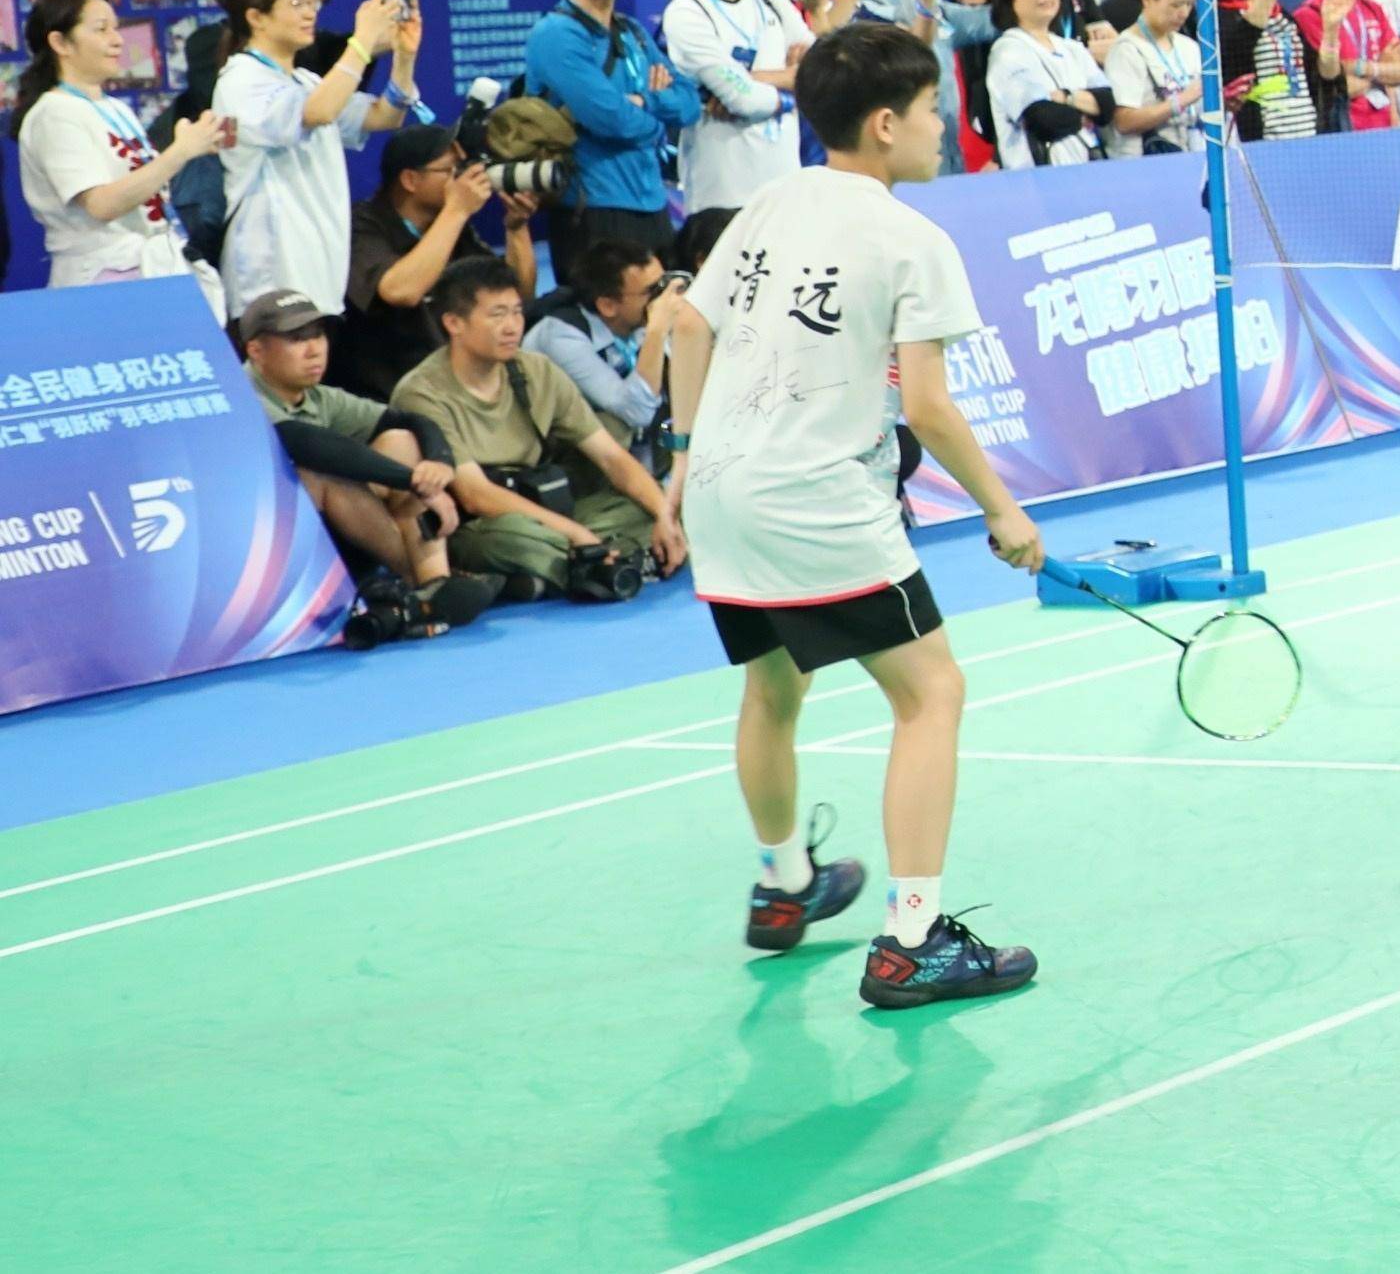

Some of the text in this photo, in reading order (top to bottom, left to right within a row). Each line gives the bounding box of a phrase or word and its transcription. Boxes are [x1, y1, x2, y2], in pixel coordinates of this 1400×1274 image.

[728, 248, 843, 336] 清远
[991, 388, 1026, 416] CUP
[32, 507, 84, 539] CUP
